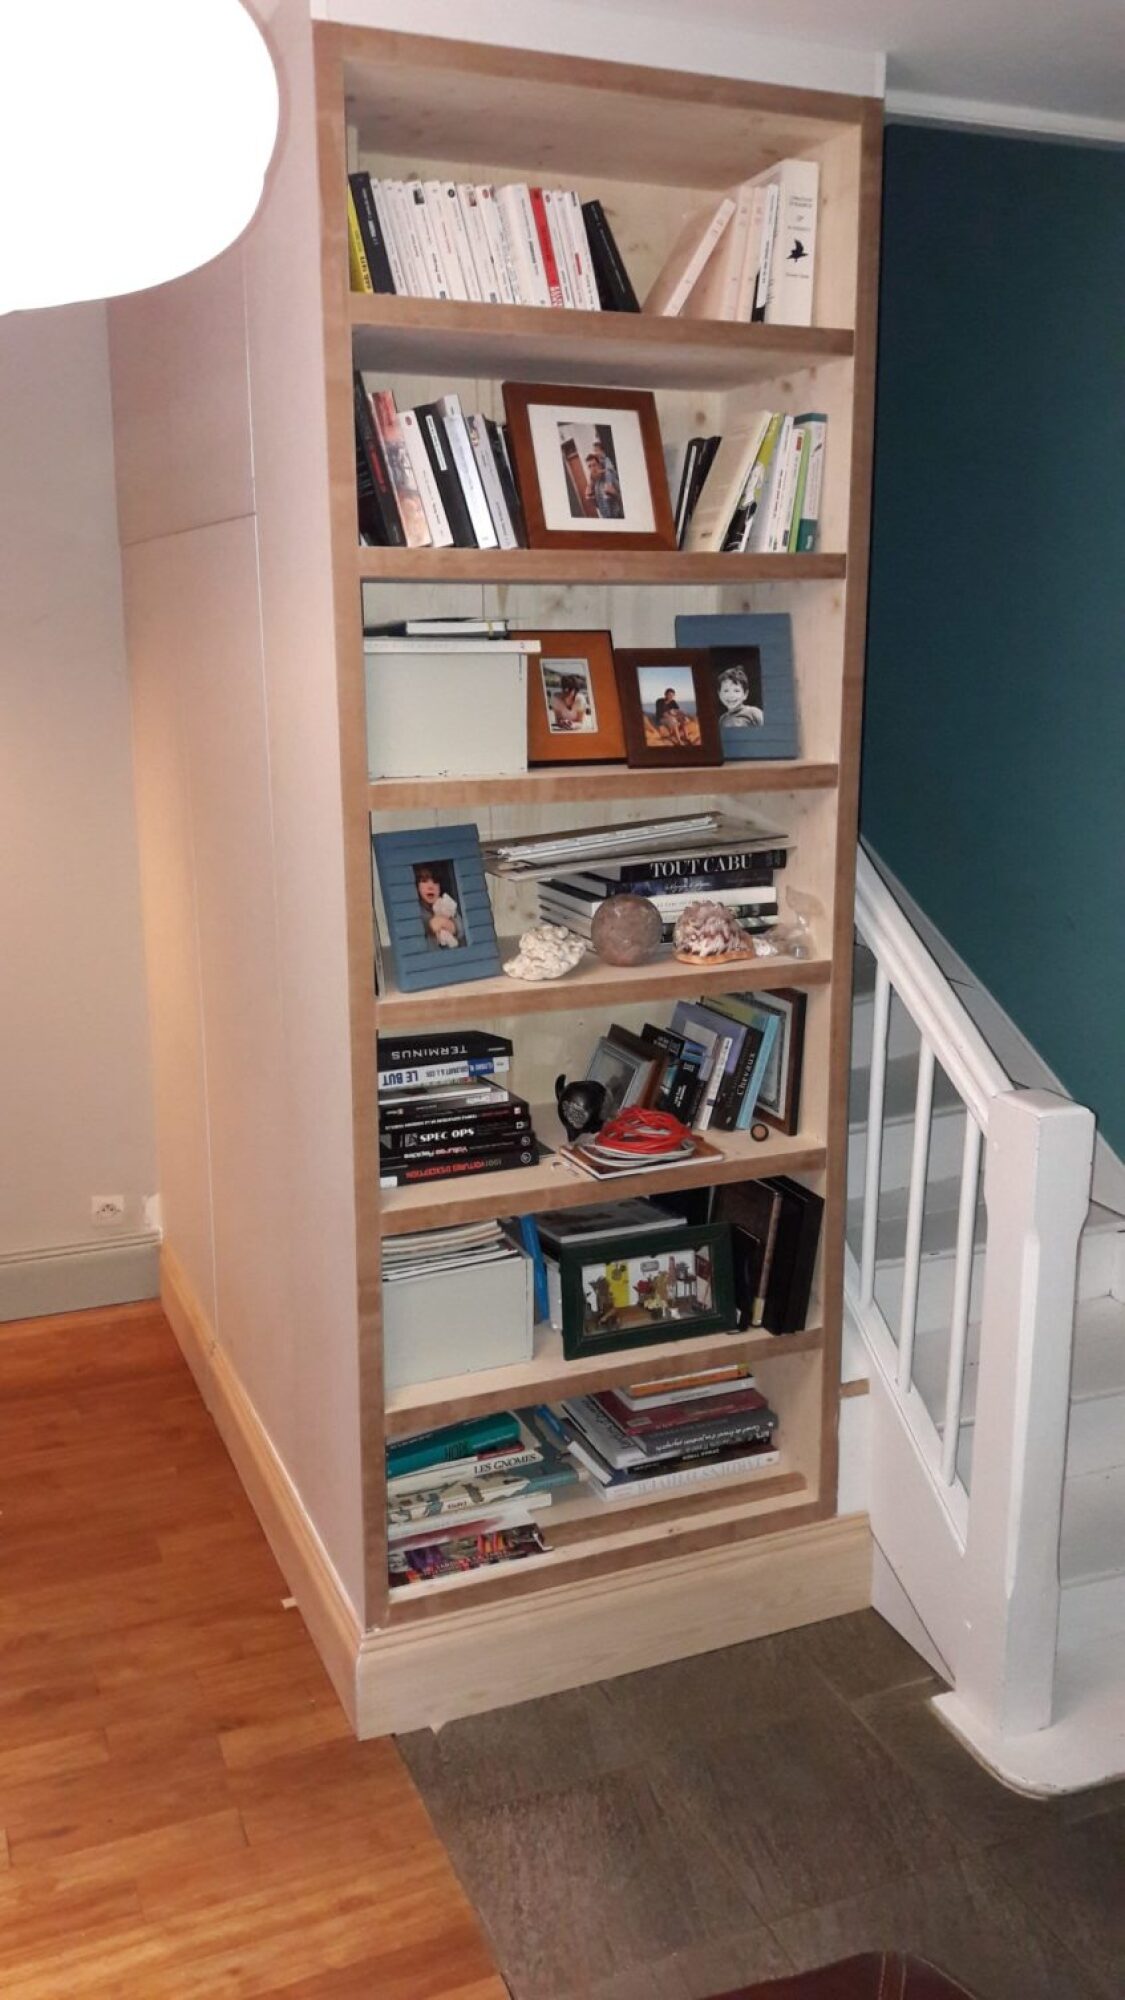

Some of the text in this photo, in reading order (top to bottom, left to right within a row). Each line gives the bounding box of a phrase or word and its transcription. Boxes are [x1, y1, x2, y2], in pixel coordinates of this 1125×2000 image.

[650, 854, 752, 877] TOUT CABU
[391, 1045, 468, 1060] TERMINUS
[383, 1070, 418, 1086] LE BUT
[420, 1128, 475, 1142] SPEC OPS
[474, 1454, 536, 1474] LES GNOMES
